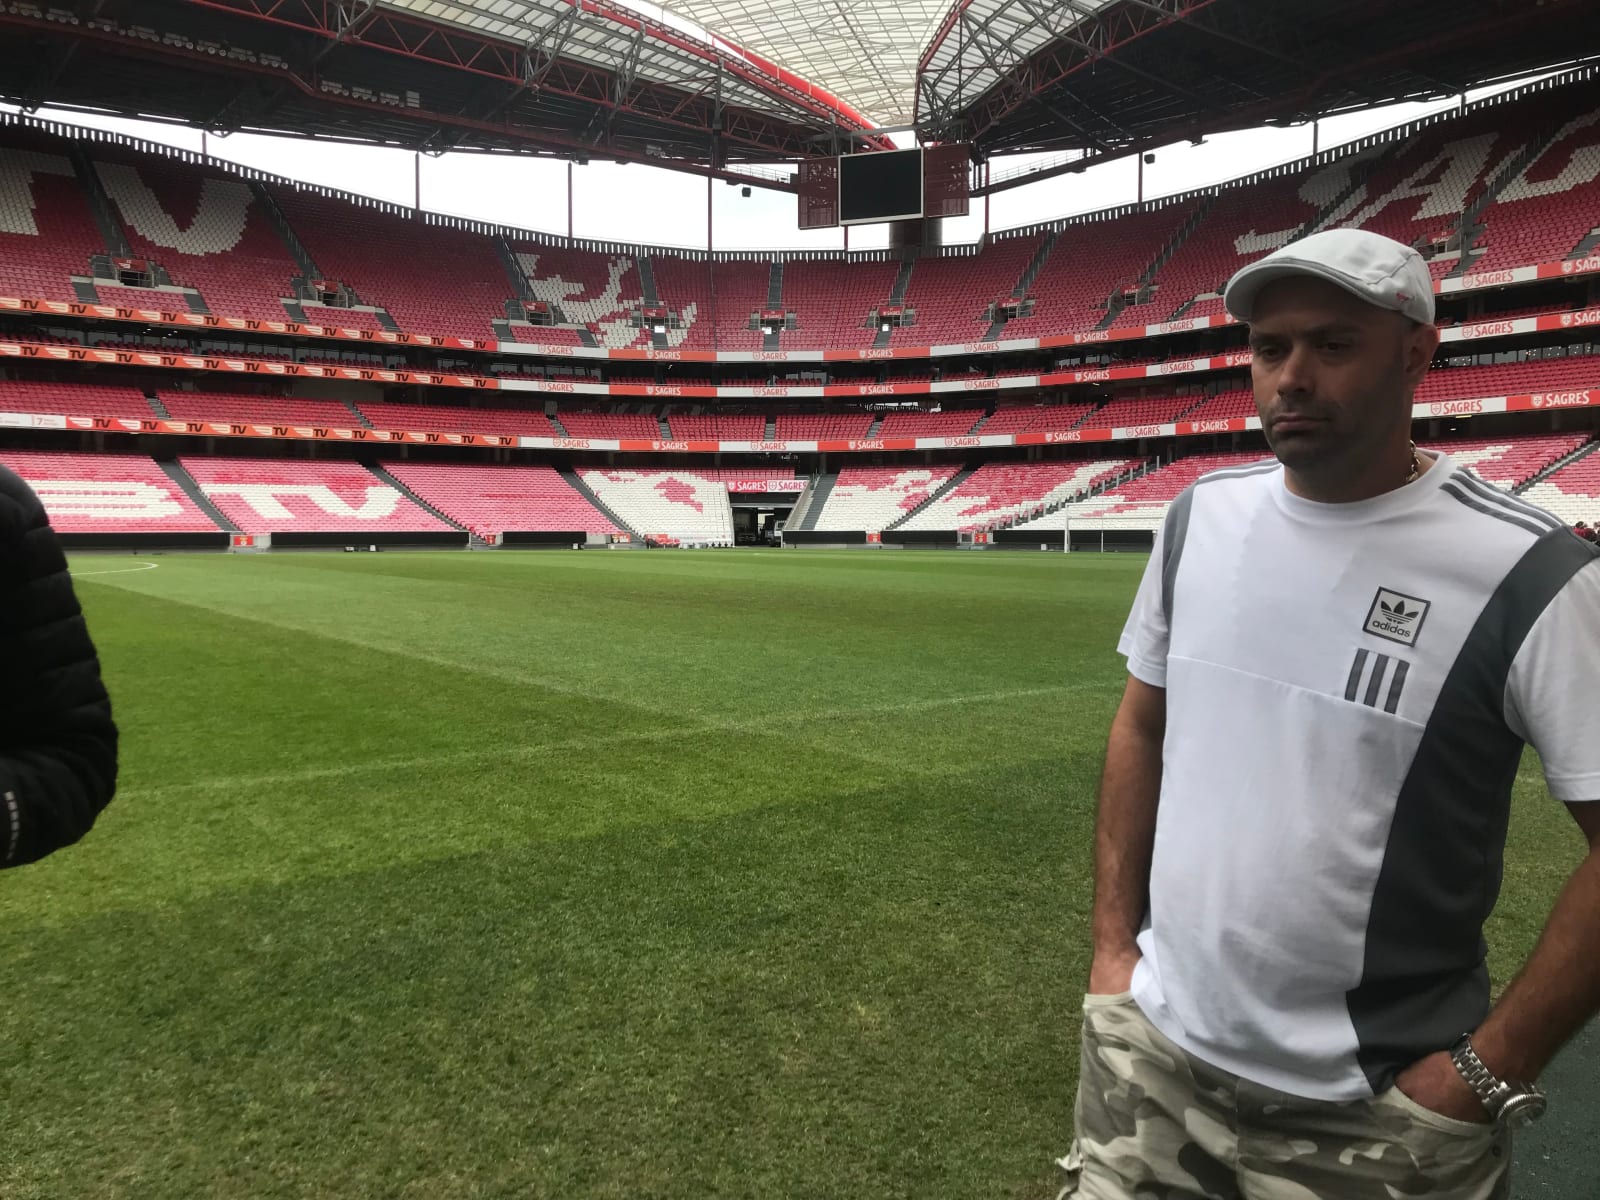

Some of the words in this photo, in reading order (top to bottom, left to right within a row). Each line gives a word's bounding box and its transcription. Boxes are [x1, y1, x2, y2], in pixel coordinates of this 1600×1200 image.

[1576, 257, 1600, 272] SAG
[1475, 272, 1513, 286] SAGRES
[1169, 320, 1194, 332] SAGRES
[1475, 322, 1513, 337] SAGRES
[1083, 331, 1109, 342] SAGRES
[548, 345, 574, 355] SAGRES
[972, 342, 999, 352] SAGRES
[656, 351, 680, 360] SAGRES
[762, 352, 788, 361] SAGRES
[868, 349, 893, 358] SAGRES
[1169, 361, 1195, 373] SAGRES
[1083, 370, 1110, 380] SAGRES
[548, 382, 574, 392] SAGRES
[973, 379, 1000, 389] SAGRES
[656, 387, 680, 396] SAGRES
[762, 387, 788, 396] SAGRES
[868, 385, 894, 394] SAGRES
[1546, 391, 1589, 406] SAGRES
[1444, 400, 1482, 413] SAGRES
[1201, 420, 1228, 432] SAGRES
[1054, 431, 1080, 441] SAGRES
[1135, 426, 1160, 437] SAGRES
[563, 439, 590, 448] SAGRES
[662, 441, 688, 450] SAGRES
[762, 442, 786, 450] SAGRES
[858, 440, 884, 449] SAGRES
[954, 437, 981, 446] SAGRES
[737, 482, 766, 491] SAGRES
[777, 482, 806, 491] SAGRES
[1372, 619, 1411, 638] adidas
